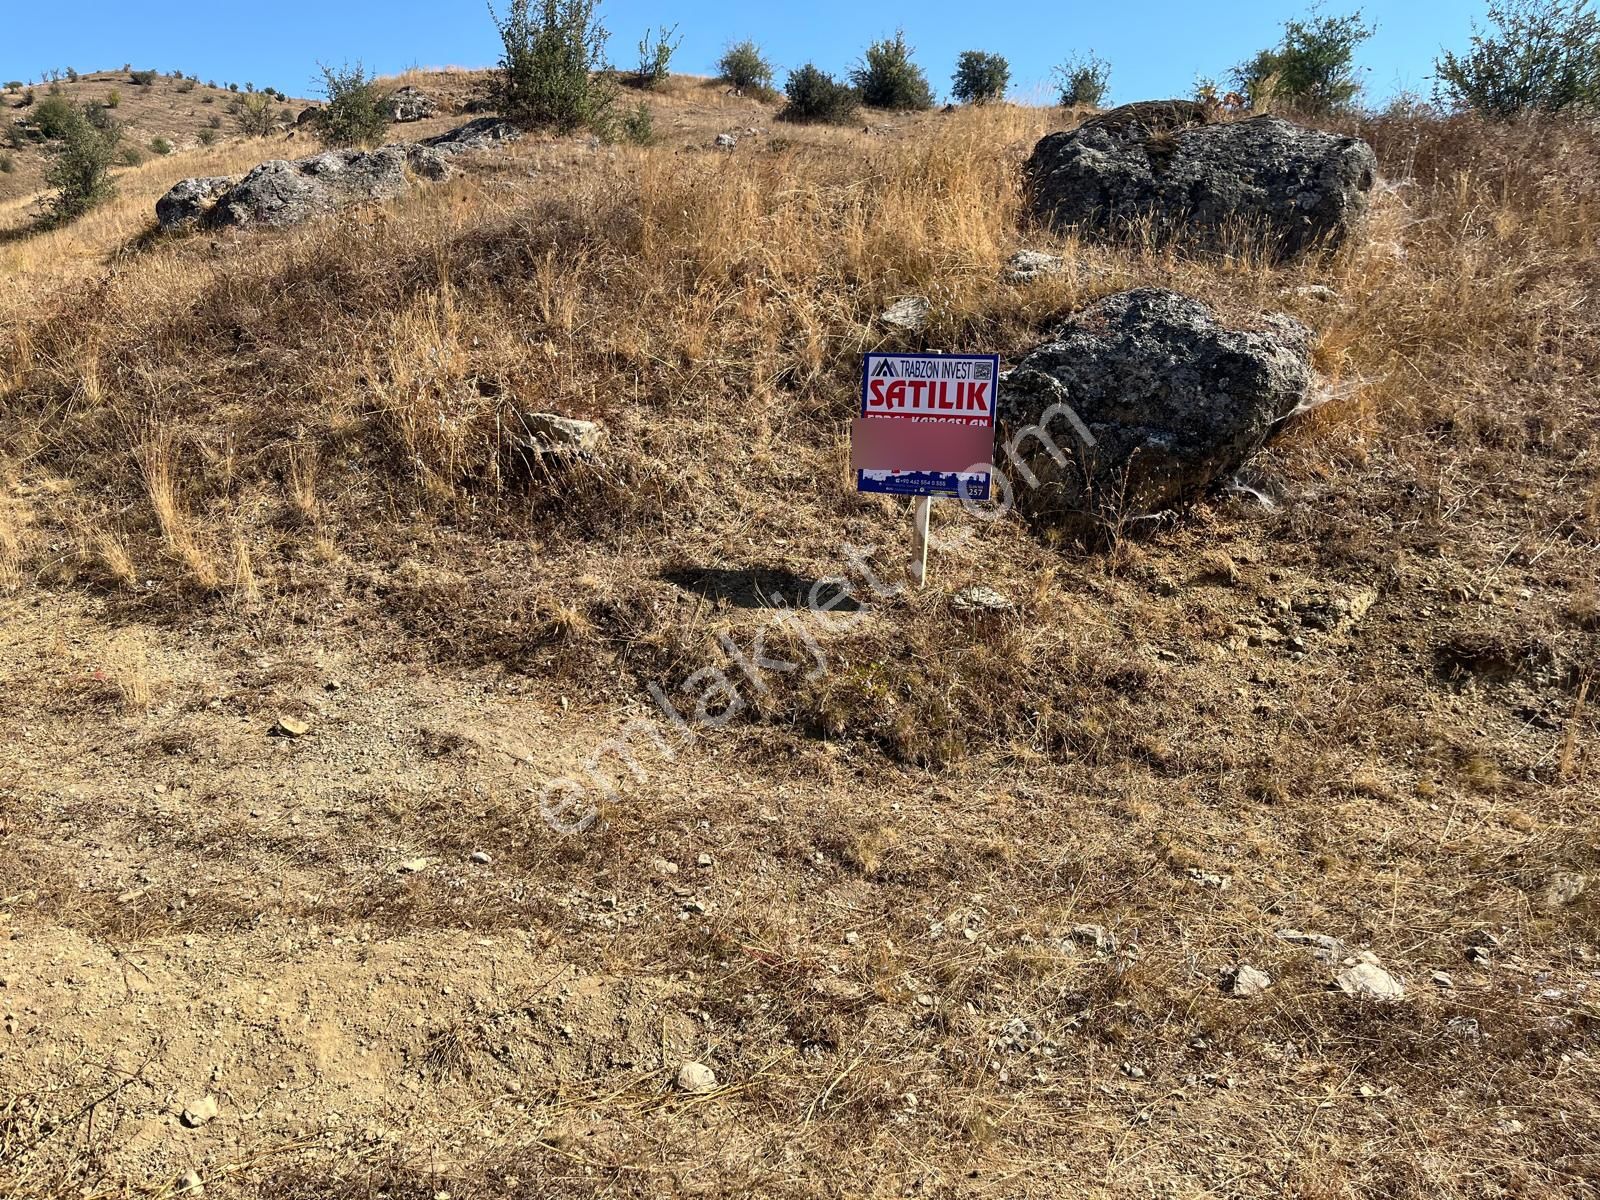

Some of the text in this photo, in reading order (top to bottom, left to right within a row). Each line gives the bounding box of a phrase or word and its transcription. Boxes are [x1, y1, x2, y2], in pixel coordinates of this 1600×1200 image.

[900, 360, 973, 380] TRABZON INVEST
[869, 379, 989, 411] SATILIK
[968, 488, 983, 497] 257
